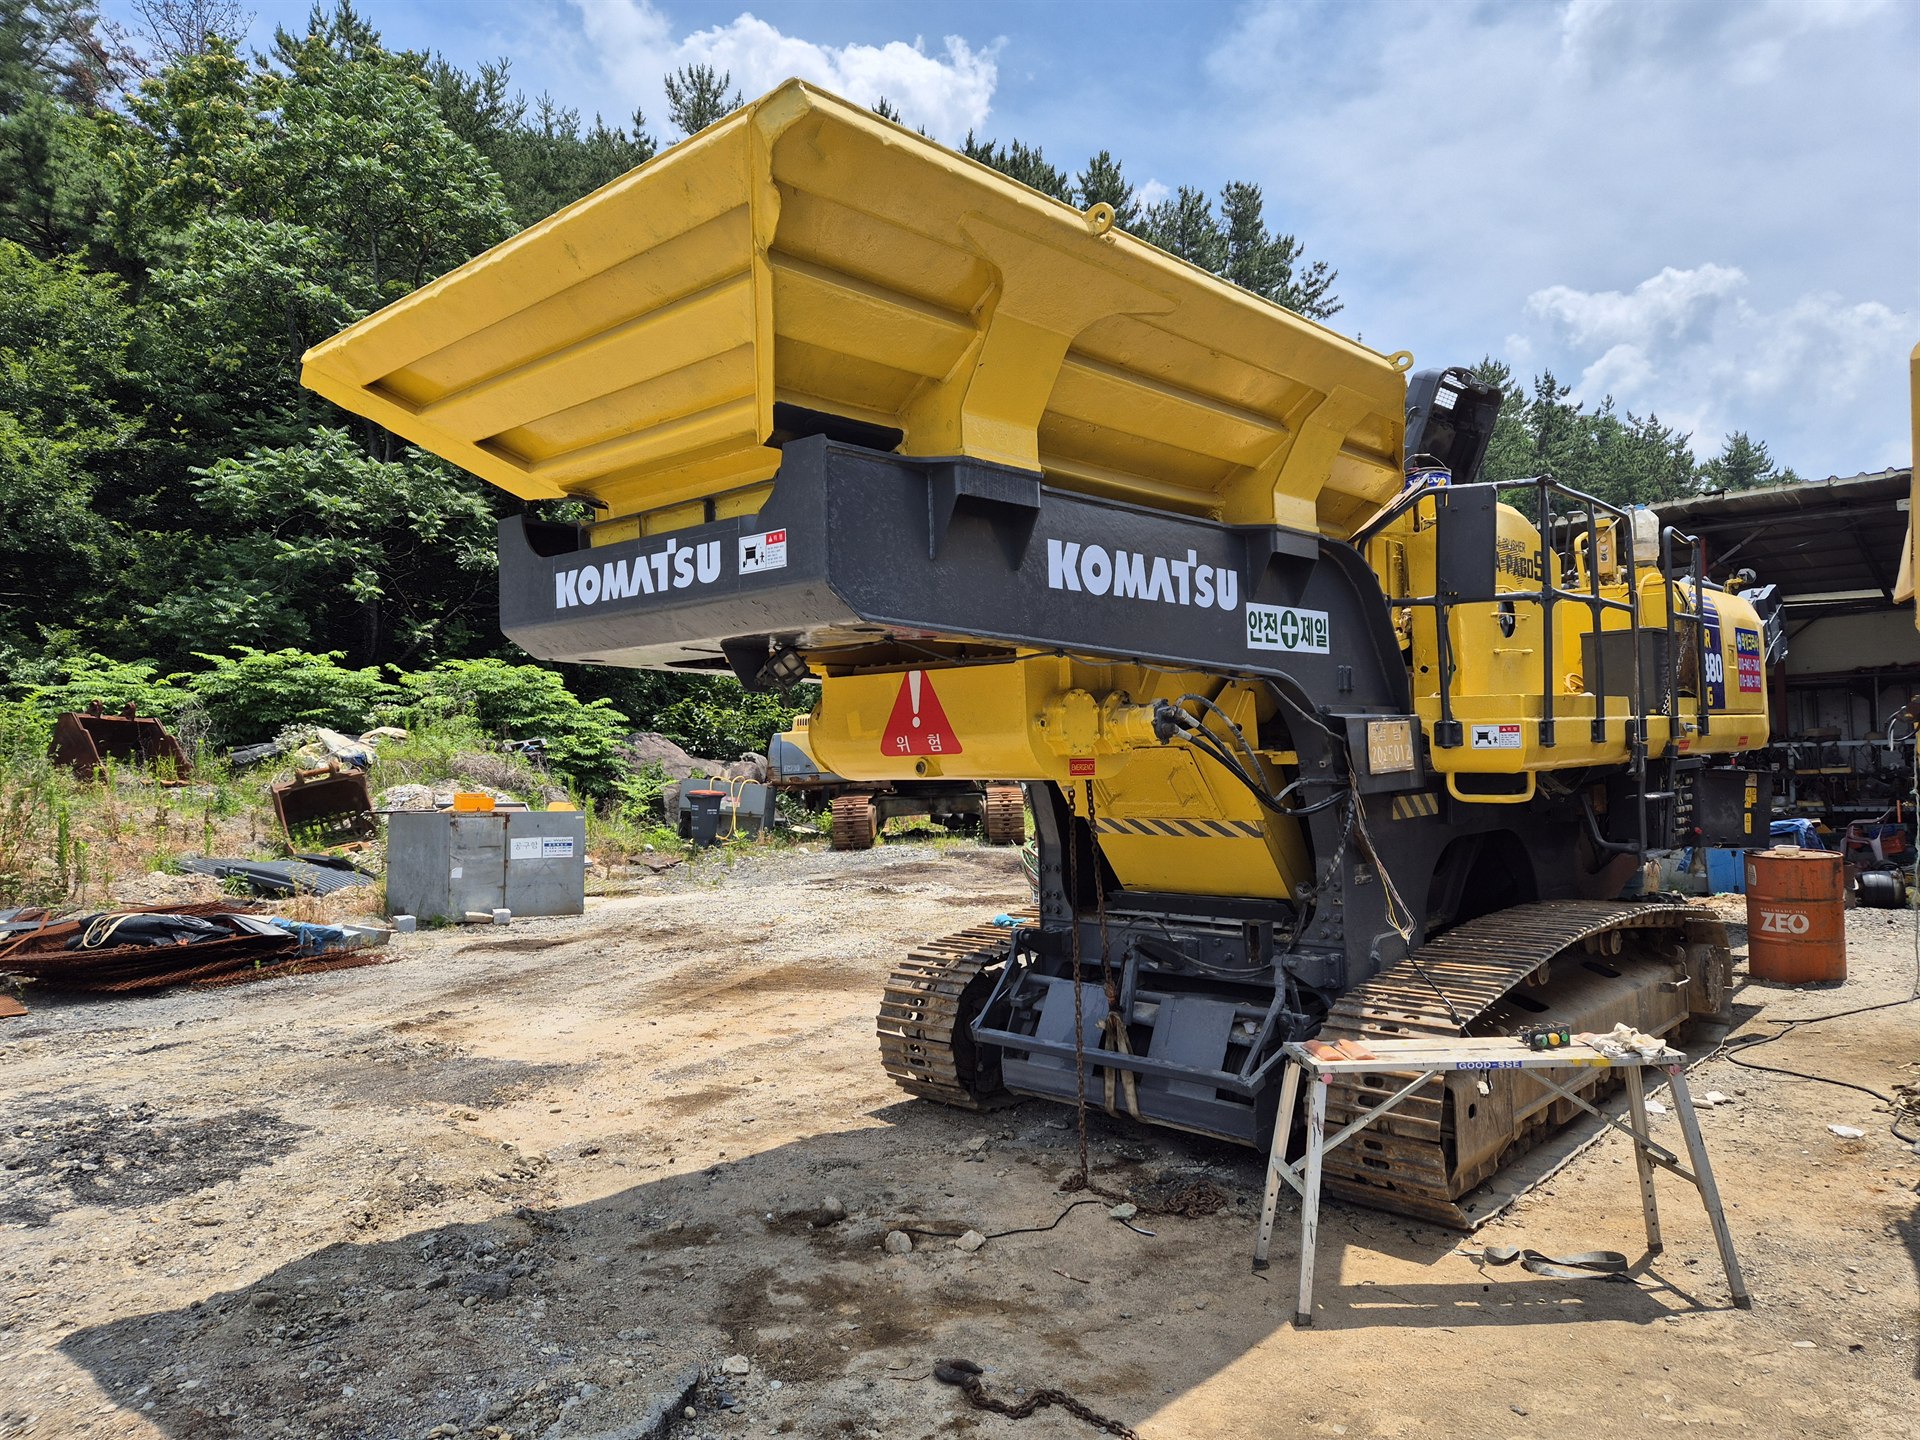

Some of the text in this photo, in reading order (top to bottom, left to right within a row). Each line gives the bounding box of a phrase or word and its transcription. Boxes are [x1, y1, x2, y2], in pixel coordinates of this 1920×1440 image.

[555, 538, 721, 609] KOMATSU
[1047, 538, 1238, 611] KOMATSU
[1248, 610, 1327, 647] 안전 제일
[1760, 911, 1810, 935] ZEO
